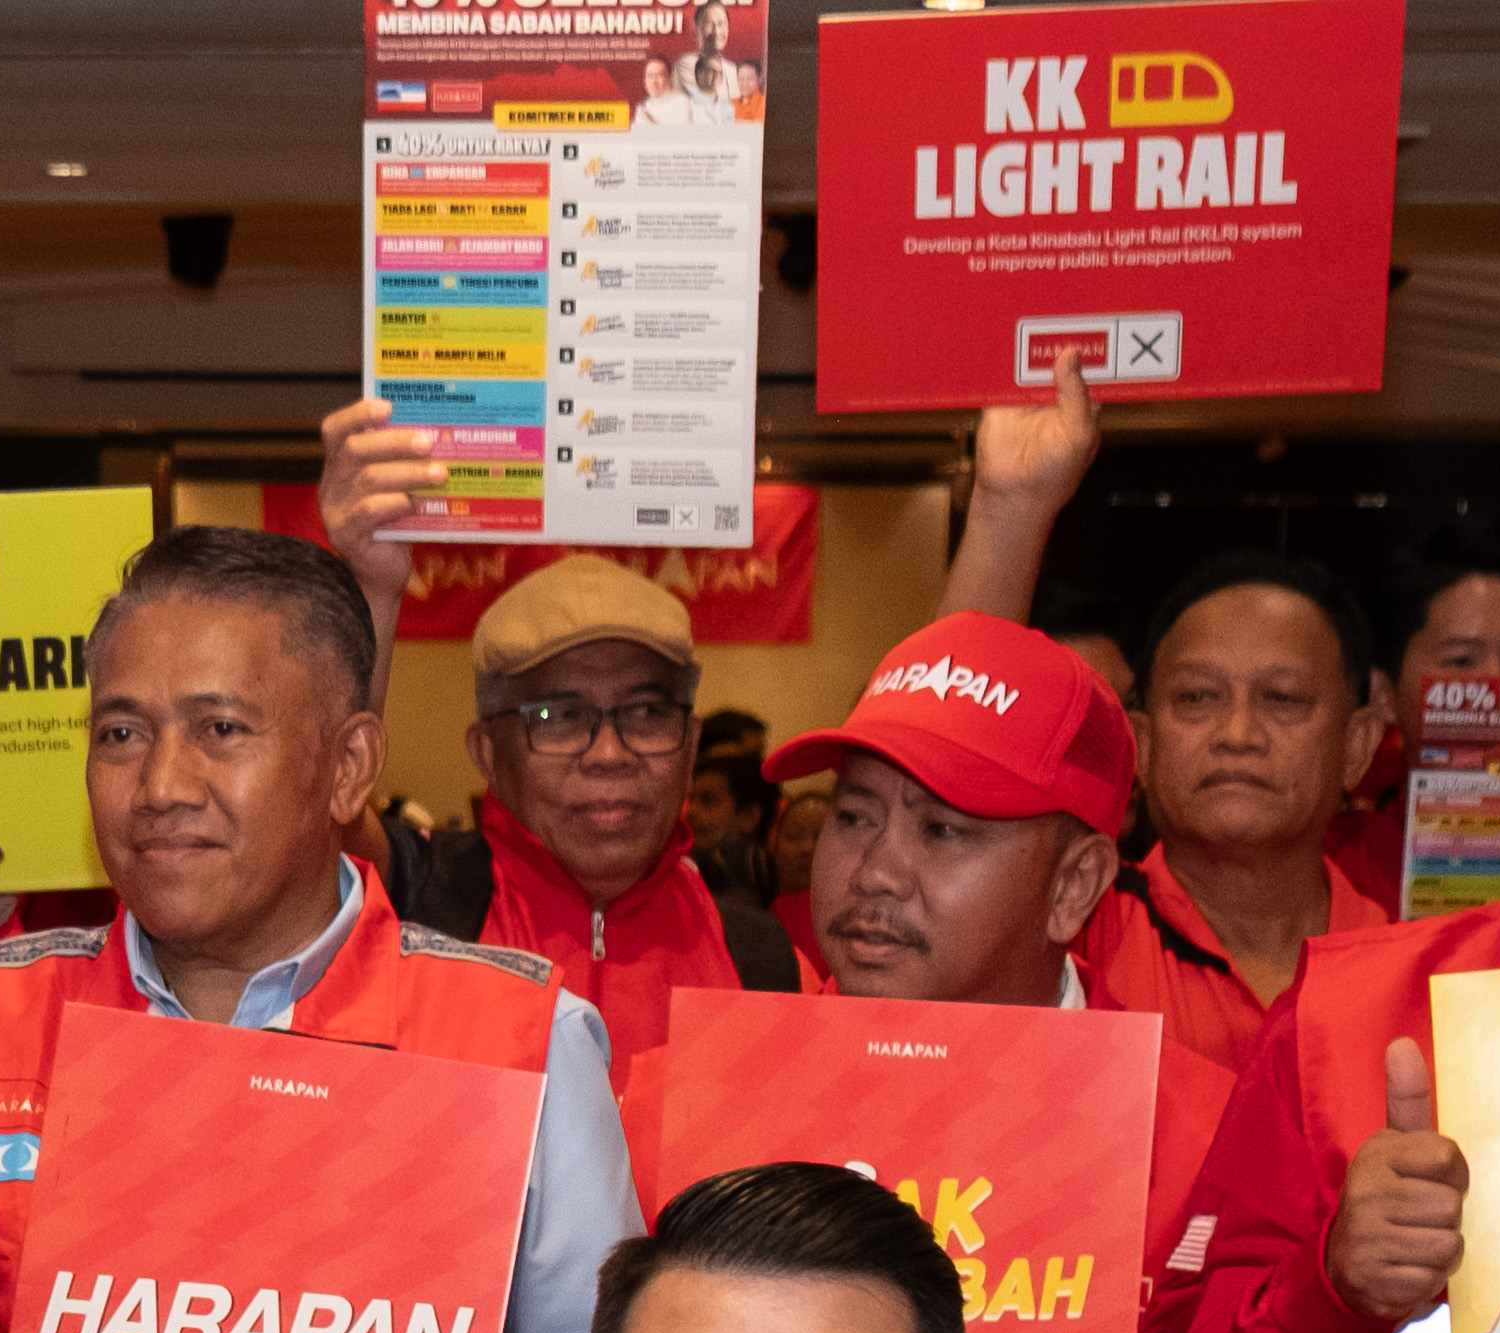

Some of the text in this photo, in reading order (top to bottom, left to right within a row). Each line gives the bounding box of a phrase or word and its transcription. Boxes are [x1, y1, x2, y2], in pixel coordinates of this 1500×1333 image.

[376, 11, 683, 35] MEMBINA SABAH BAHARU!
[985, 55, 1088, 133] KK
[915, 130, 1298, 220] LIGHT RAIL
[904, 235, 972, 255] Develop
[868, 655, 1019, 716] HARAPAN
[1427, 682, 1496, 711] 40%
[868, 1042, 948, 1059] HARAPAN
[250, 1076, 329, 1100] HARAPAN
[962, 1255, 1094, 1322] BAH
